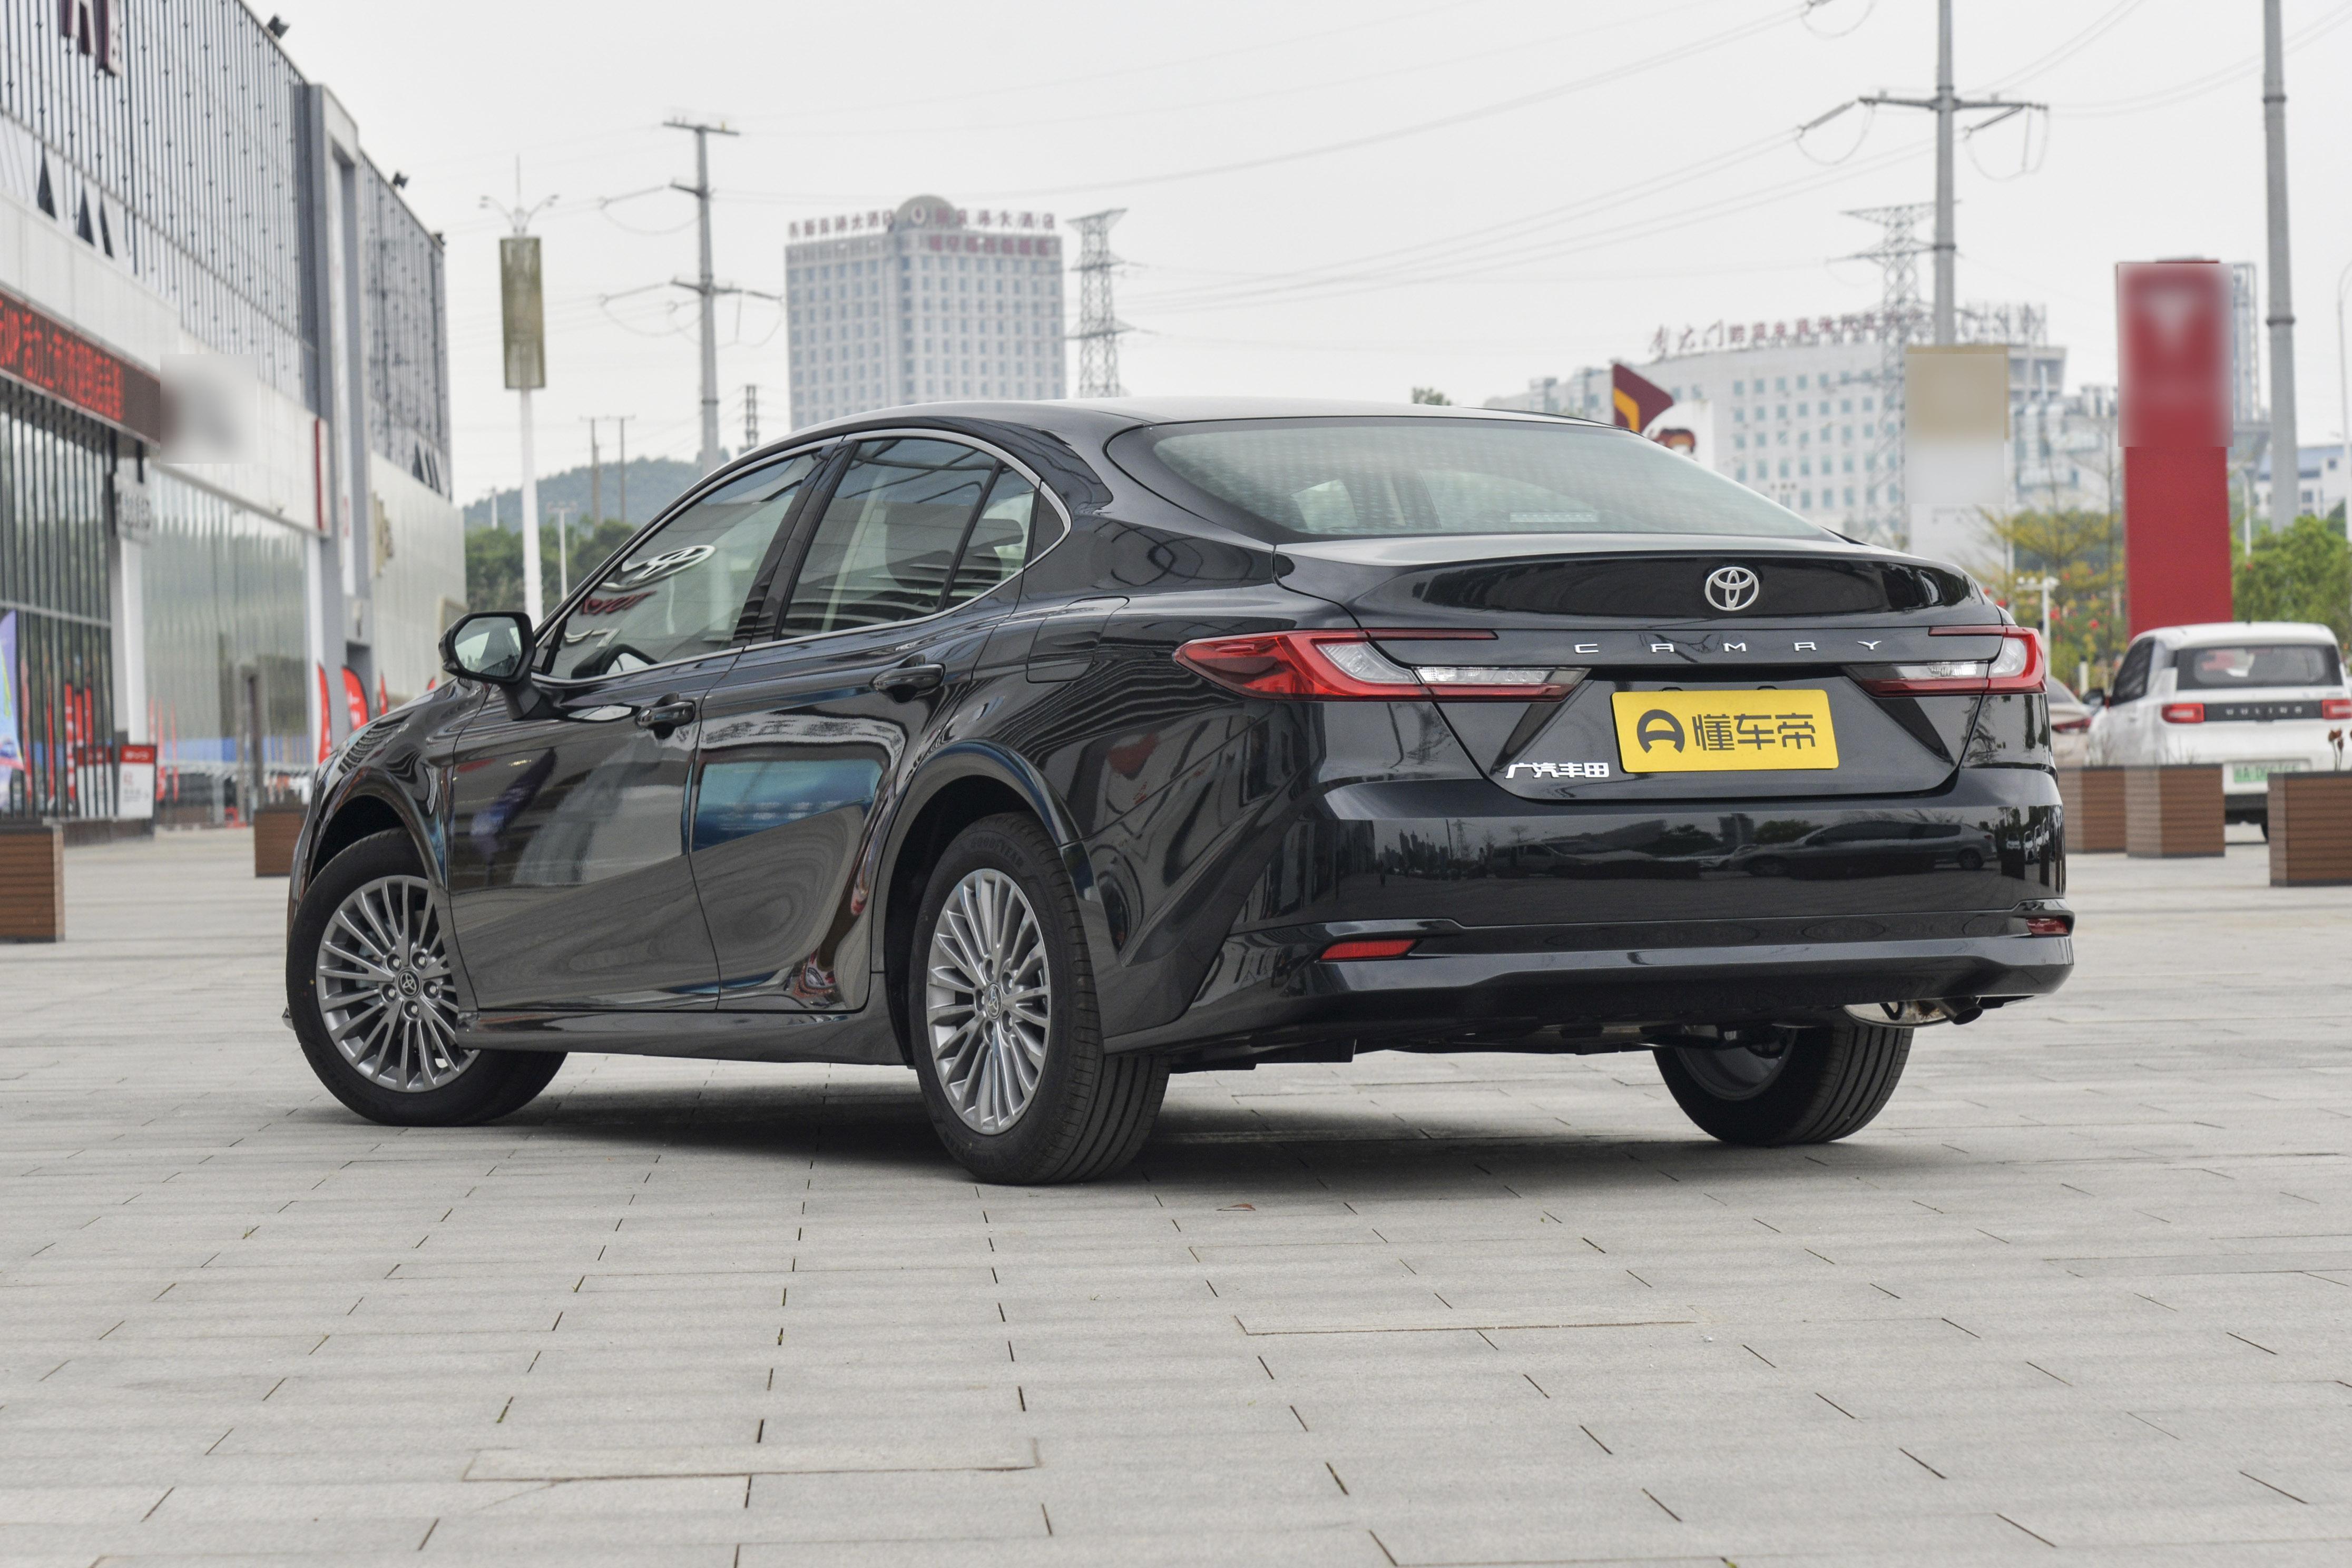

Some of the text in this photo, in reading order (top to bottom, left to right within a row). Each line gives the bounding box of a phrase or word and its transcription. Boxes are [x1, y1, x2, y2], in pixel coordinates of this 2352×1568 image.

[1574, 640, 1881, 654] CAMRY
[1692, 713, 1816, 751] 懂车帝
[1505, 762, 1610, 779] 广汽丰田
[970, 837, 1024, 868] GOODYEAR
